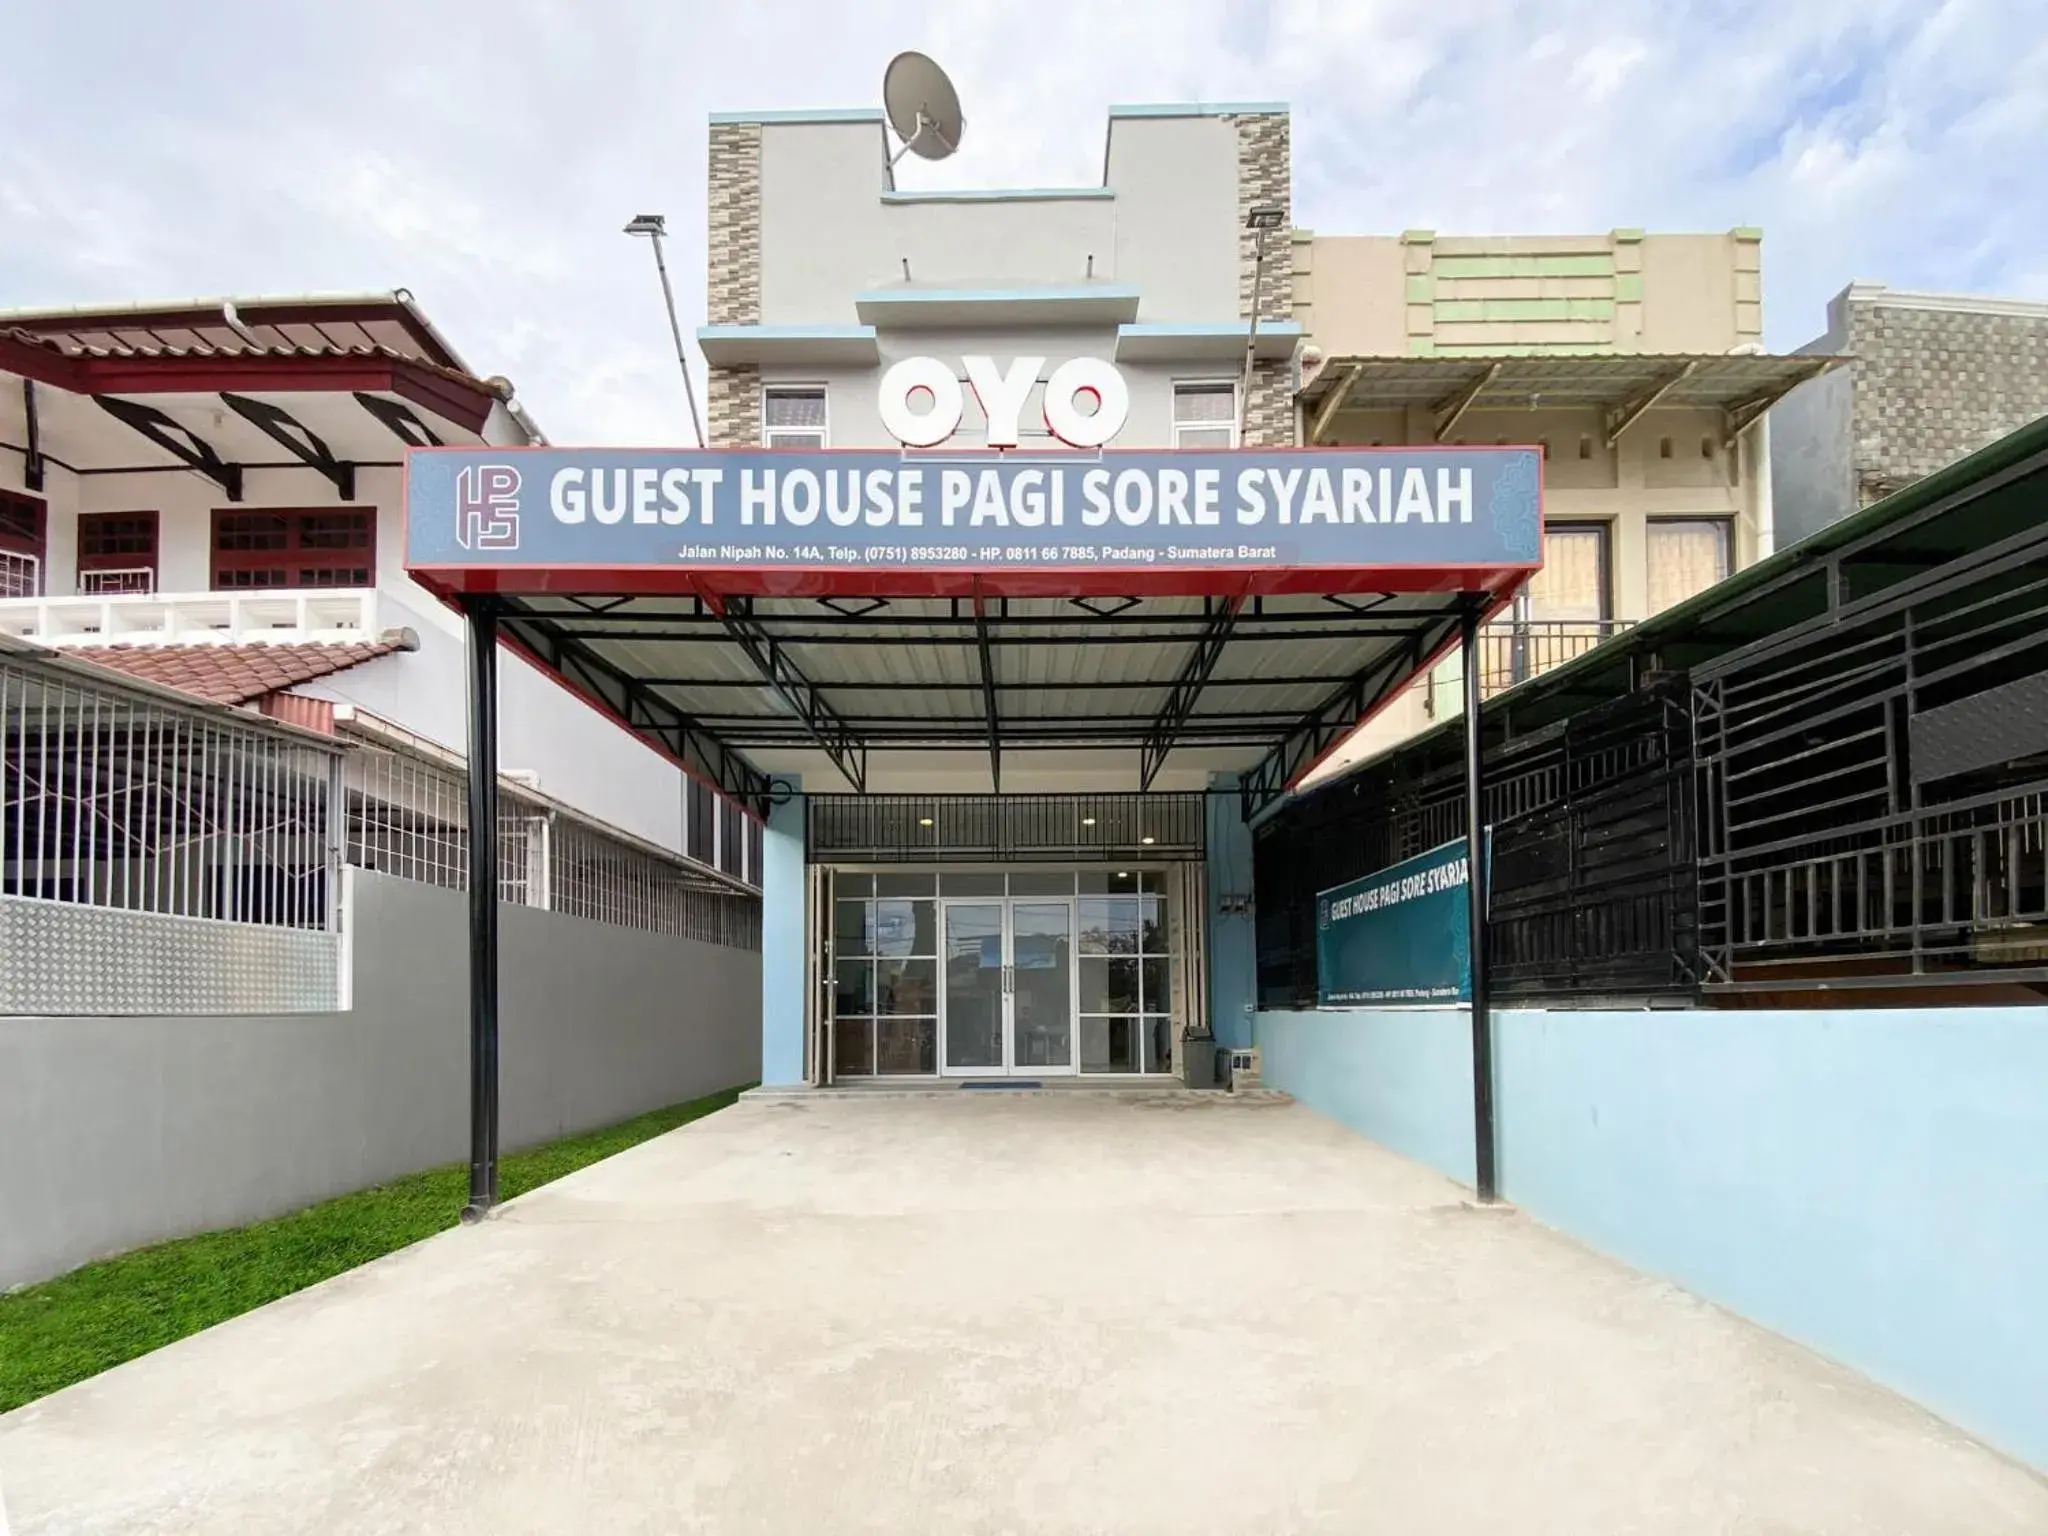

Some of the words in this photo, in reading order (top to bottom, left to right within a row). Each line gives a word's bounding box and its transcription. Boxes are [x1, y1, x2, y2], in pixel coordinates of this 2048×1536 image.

[878, 356, 1129, 448] OYO
[549, 467, 724, 525] GUEST
[740, 468, 924, 527] HOUSE
[941, 469, 1064, 527] PAGI
[1081, 468, 1221, 527] SORE
[1236, 467, 1473, 526] SYARIAH
[678, 544, 717, 559] Jalan
[720, 545, 762, 562] Nipah
[765, 546, 789, 560] No.
[794, 546, 825, 561] 14A,
[828, 546, 861, 562] Telp.
[865, 546, 908, 564] (0751)
[910, 546, 968, 561] 8953280
[979, 547, 1003, 561] HP.
[1006, 547, 1037, 561] 0811
[1041, 547, 1059, 561] 66
[1061, 546, 1099, 562] 7885,
[1102, 546, 1155, 563] Padang
[1167, 545, 1235, 560] Sumatera
[1238, 545, 1277, 559] Barat
[1331, 897, 1353, 921] GUEST
[1352, 888, 1379, 914] HOUSE
[1379, 881, 1400, 908] PAGI
[1400, 871, 1427, 902] SORE
[1427, 857, 1470, 894] SYARIA
